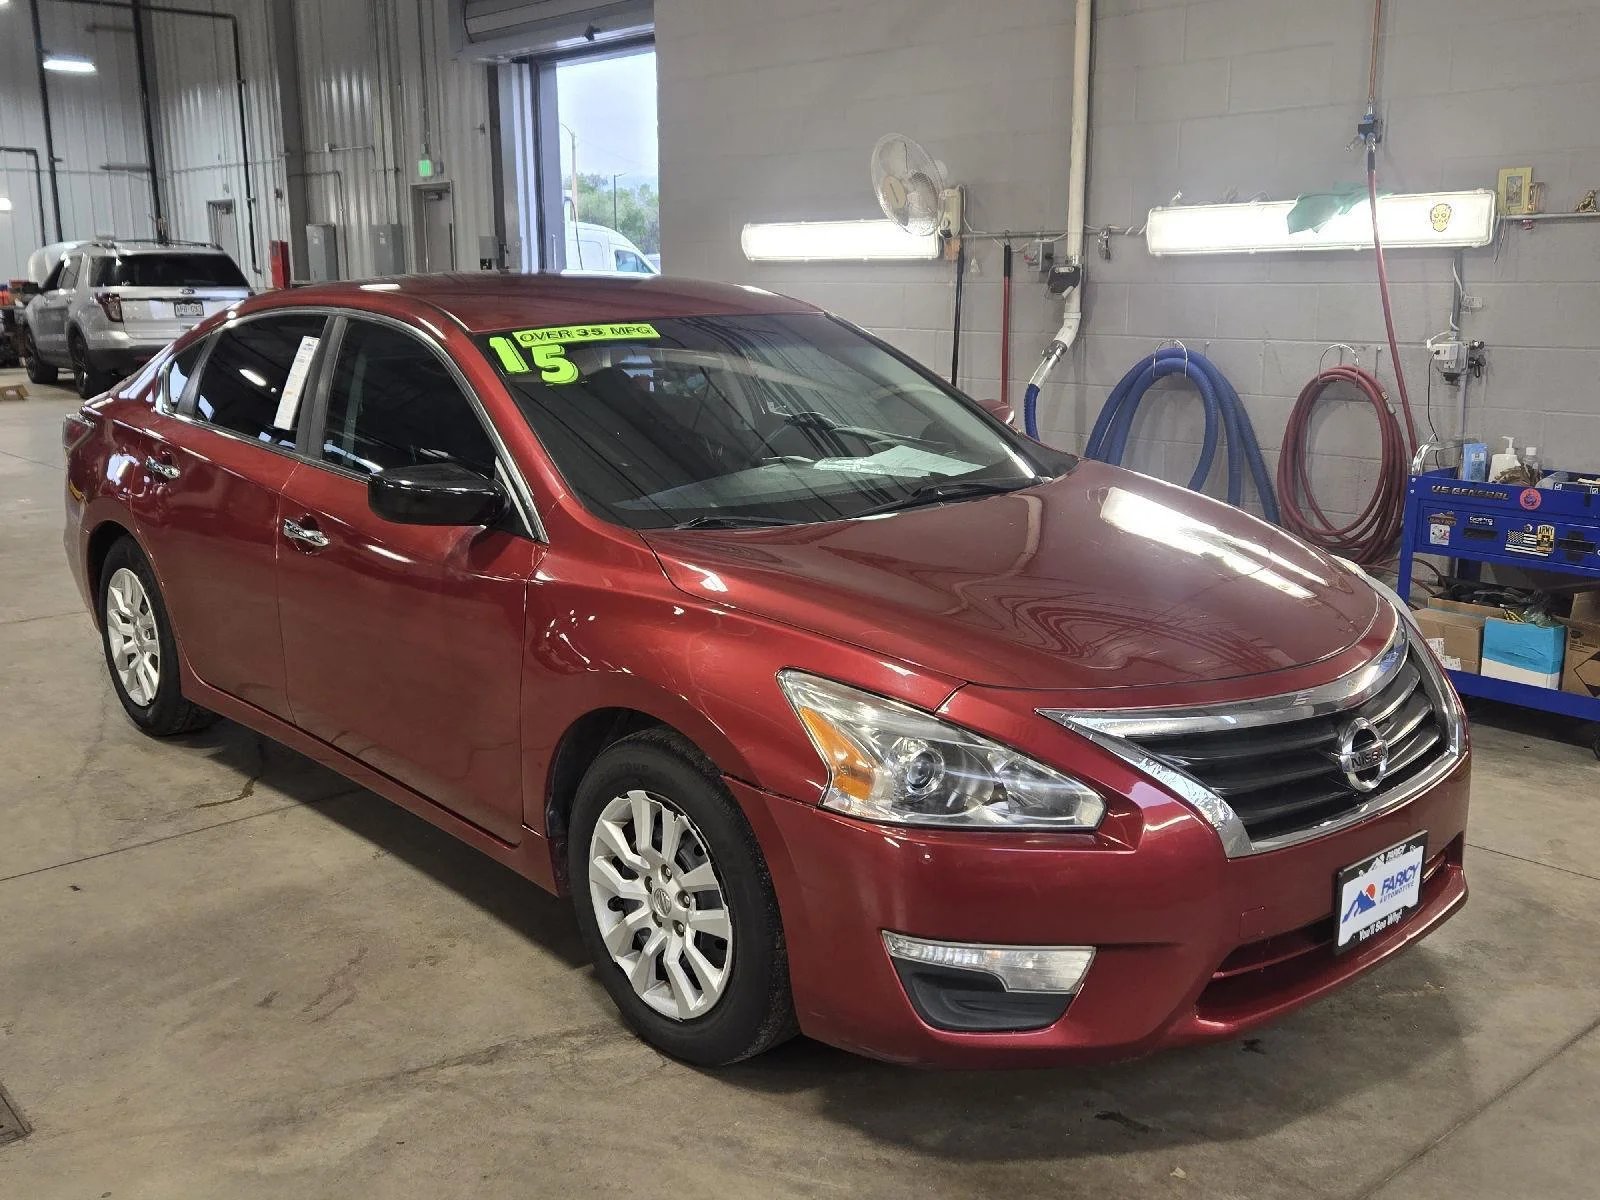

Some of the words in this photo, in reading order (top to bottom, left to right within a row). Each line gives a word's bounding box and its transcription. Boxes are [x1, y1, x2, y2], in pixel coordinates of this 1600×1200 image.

[519, 328, 573, 343] OVER
[577, 327, 604, 337] 35
[610, 325, 652, 335] MPG
[489, 337, 579, 384] 15
[1452, 487, 1509, 501] GENERAL
[1538, 524, 1554, 536] ARMY
[1381, 863, 1420, 896] FARICY
[1379, 881, 1415, 904] AUTOMOTIVE
[1375, 919, 1387, 932] See
